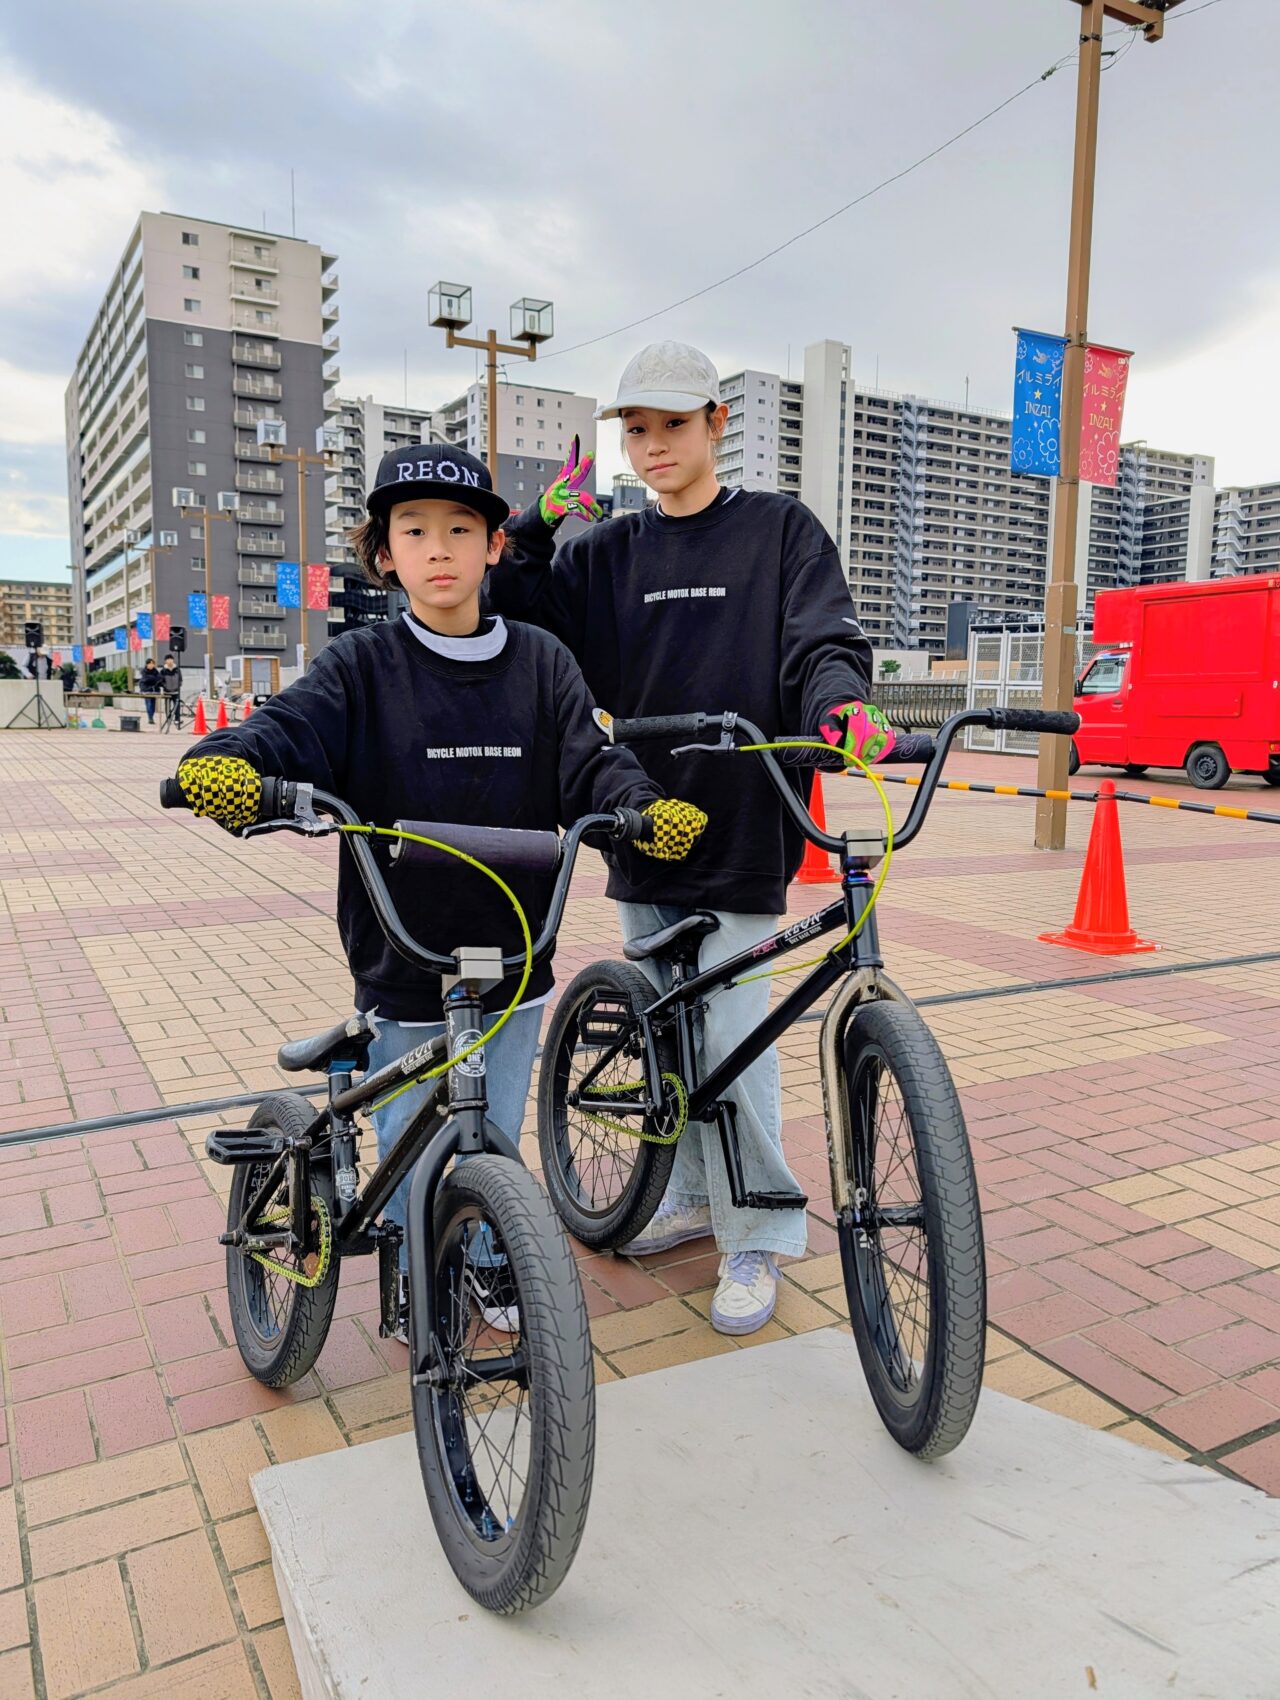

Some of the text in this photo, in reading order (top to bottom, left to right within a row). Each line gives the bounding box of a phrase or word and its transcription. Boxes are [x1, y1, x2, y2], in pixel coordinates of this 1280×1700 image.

[1017, 369, 1061, 386] イルミライ
[1024, 401, 1052, 418] INZAI
[1089, 413, 1114, 431] INZAI
[396, 460, 479, 487] REON
[644, 590, 666, 603] BICYCLE
[690, 587, 707, 597] BASE
[708, 587, 726, 597] REON
[426, 746, 522, 759] BICYCLE MOTOX BASE REON
